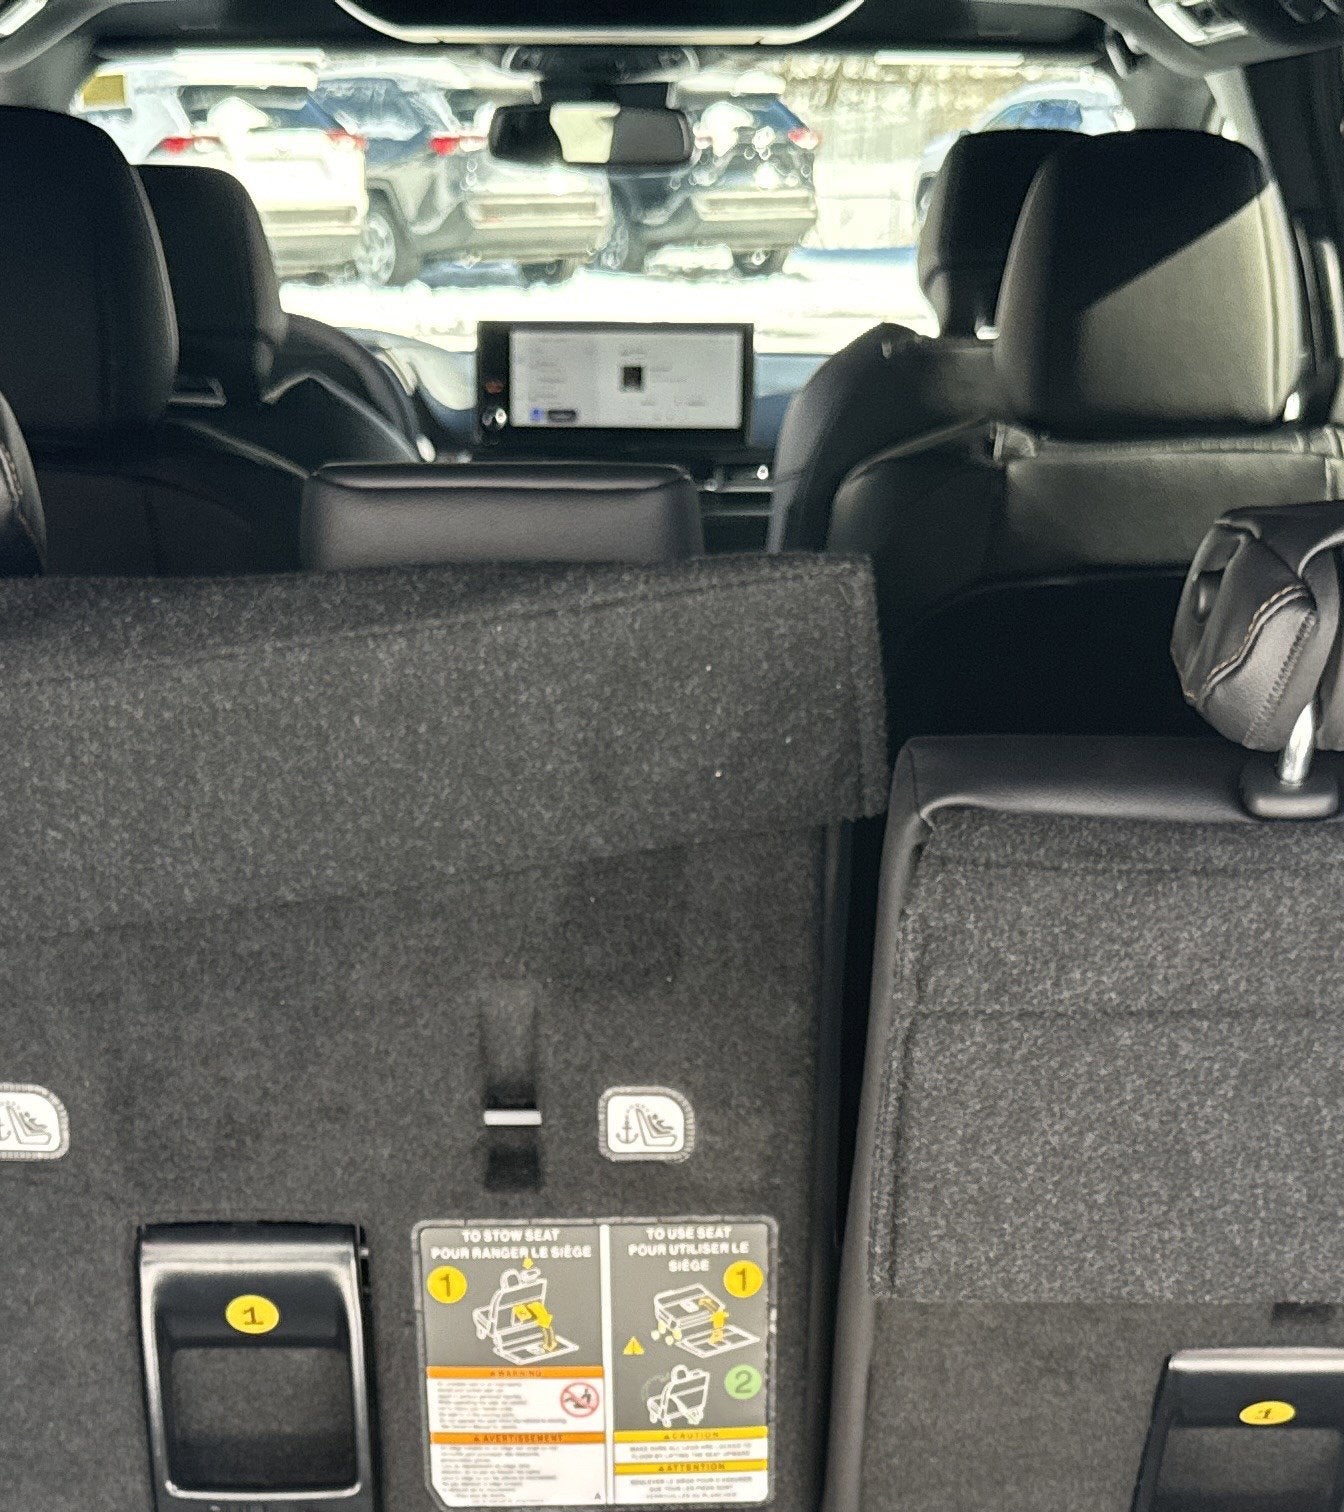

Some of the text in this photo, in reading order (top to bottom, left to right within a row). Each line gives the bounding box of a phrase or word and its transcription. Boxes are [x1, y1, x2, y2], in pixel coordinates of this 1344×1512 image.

[462, 1228, 561, 1243] TO STOW SEAT
[646, 1225, 733, 1240] TO USE SEAT
[430, 1247, 469, 1260] POUR
[472, 1246, 529, 1260] RANGER
[531, 1246, 549, 1259] LE
[627, 1240, 750, 1257] POUR UTILISER LE
[243, 1306, 265, 1325] 1
[483, 1433, 564, 1443] AVERTISSEMENT
[667, 1462, 726, 1473] ATTENTION
